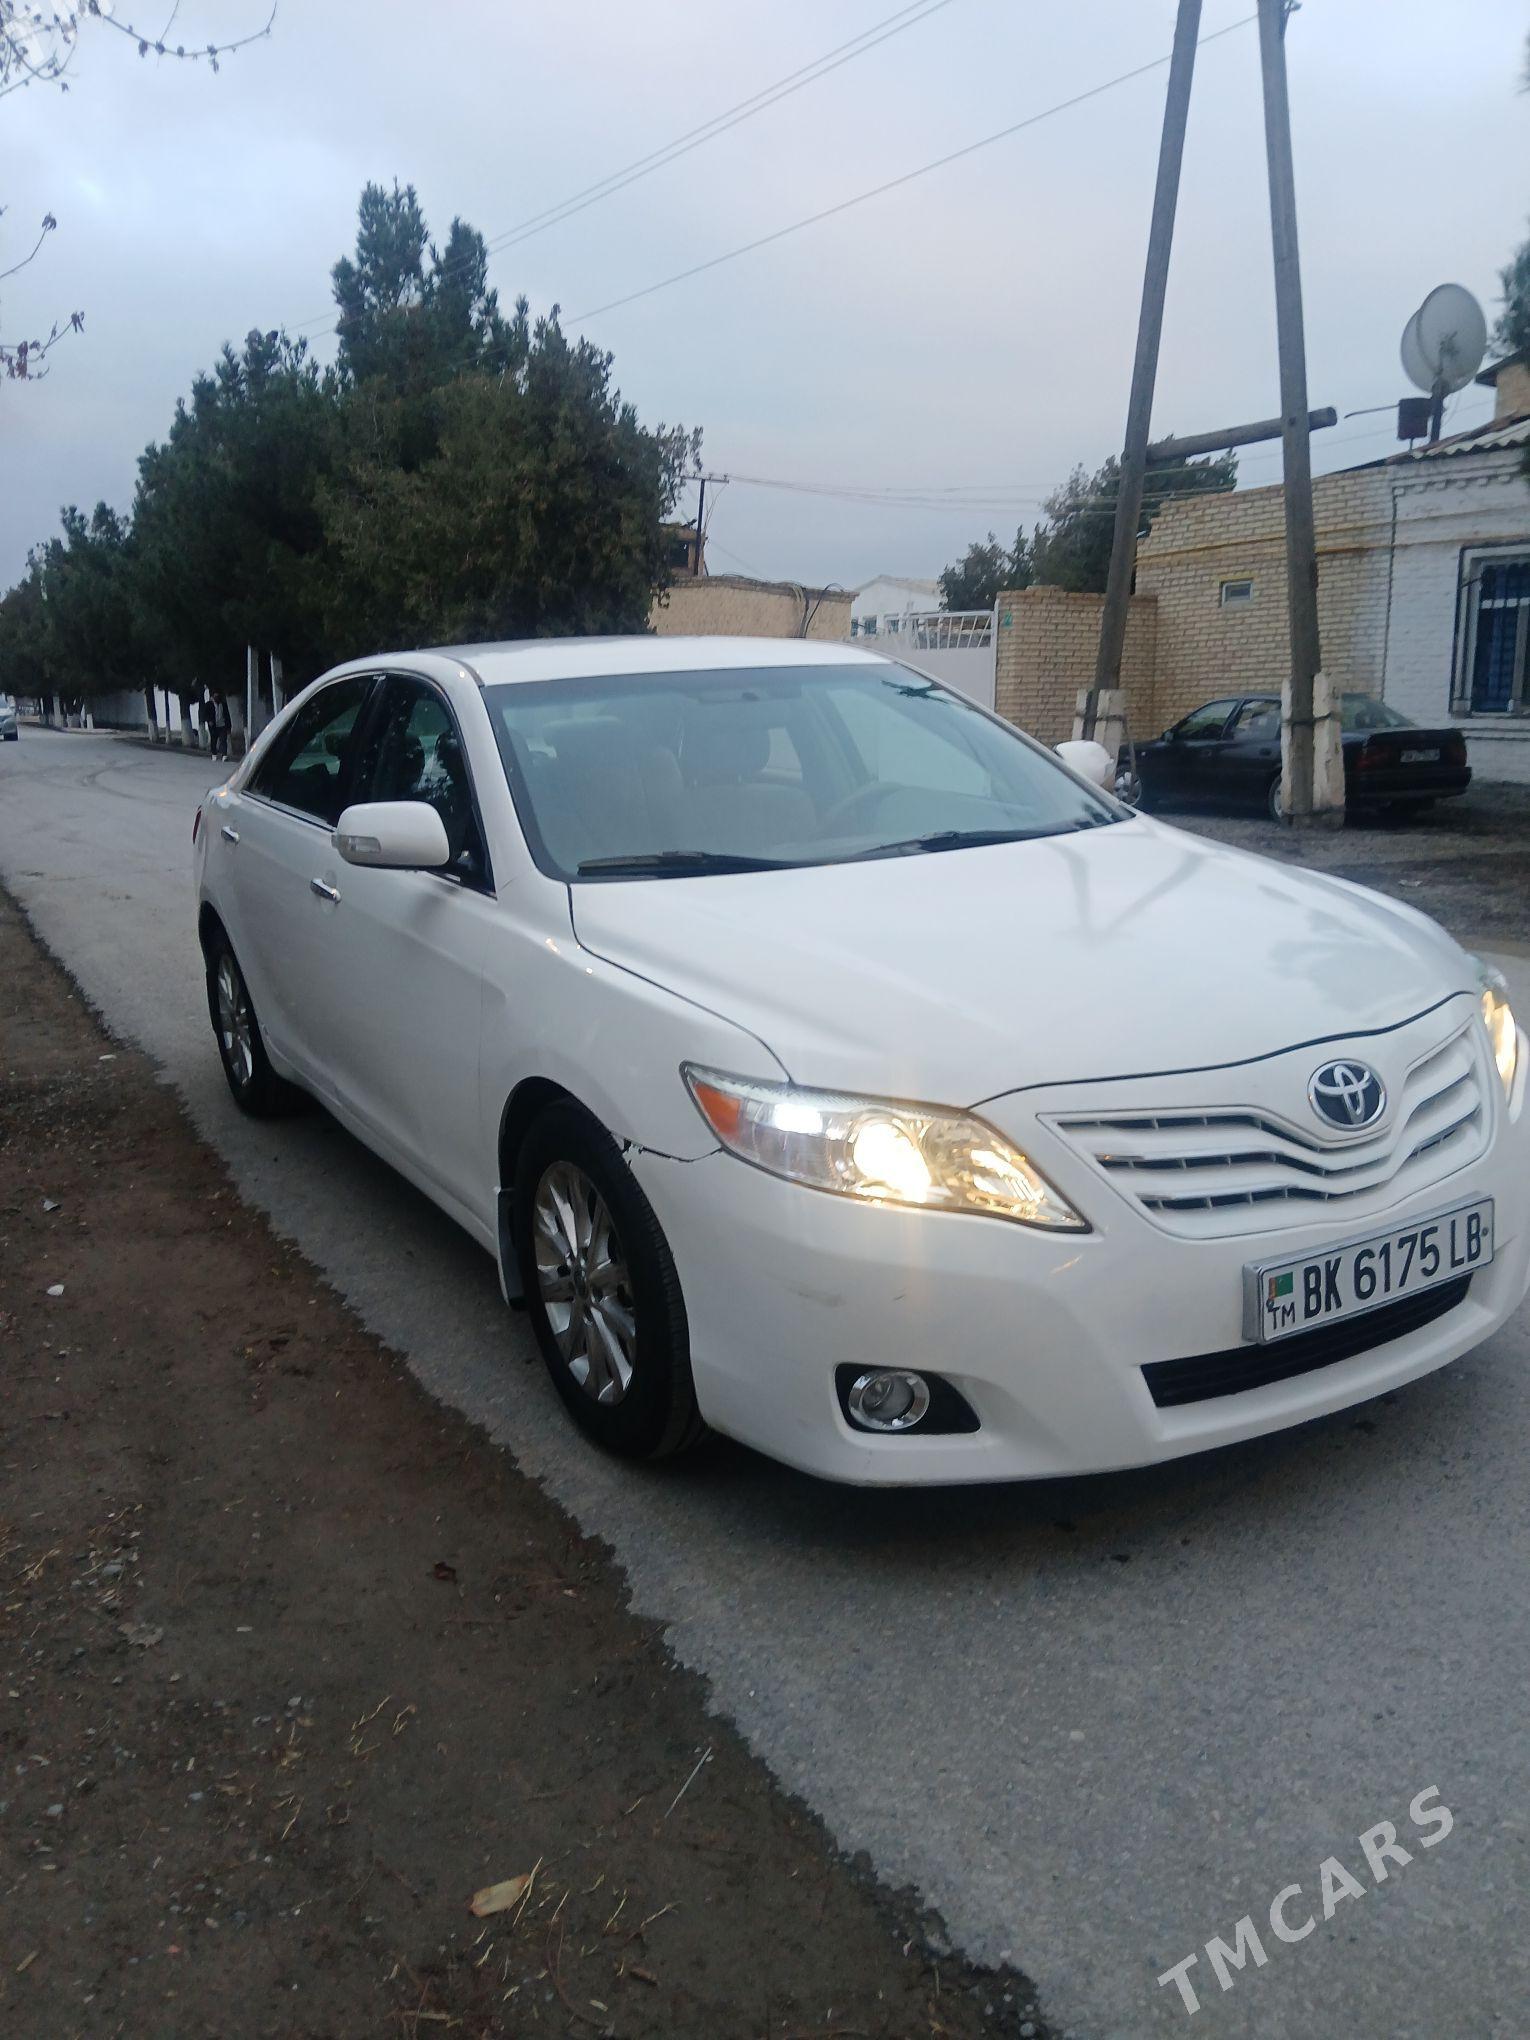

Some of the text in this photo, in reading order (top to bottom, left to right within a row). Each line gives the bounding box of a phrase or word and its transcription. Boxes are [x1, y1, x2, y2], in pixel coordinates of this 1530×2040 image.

[1303, 1212, 1481, 1319] BK 6175 LB
[1270, 1301, 1296, 1330] TM
